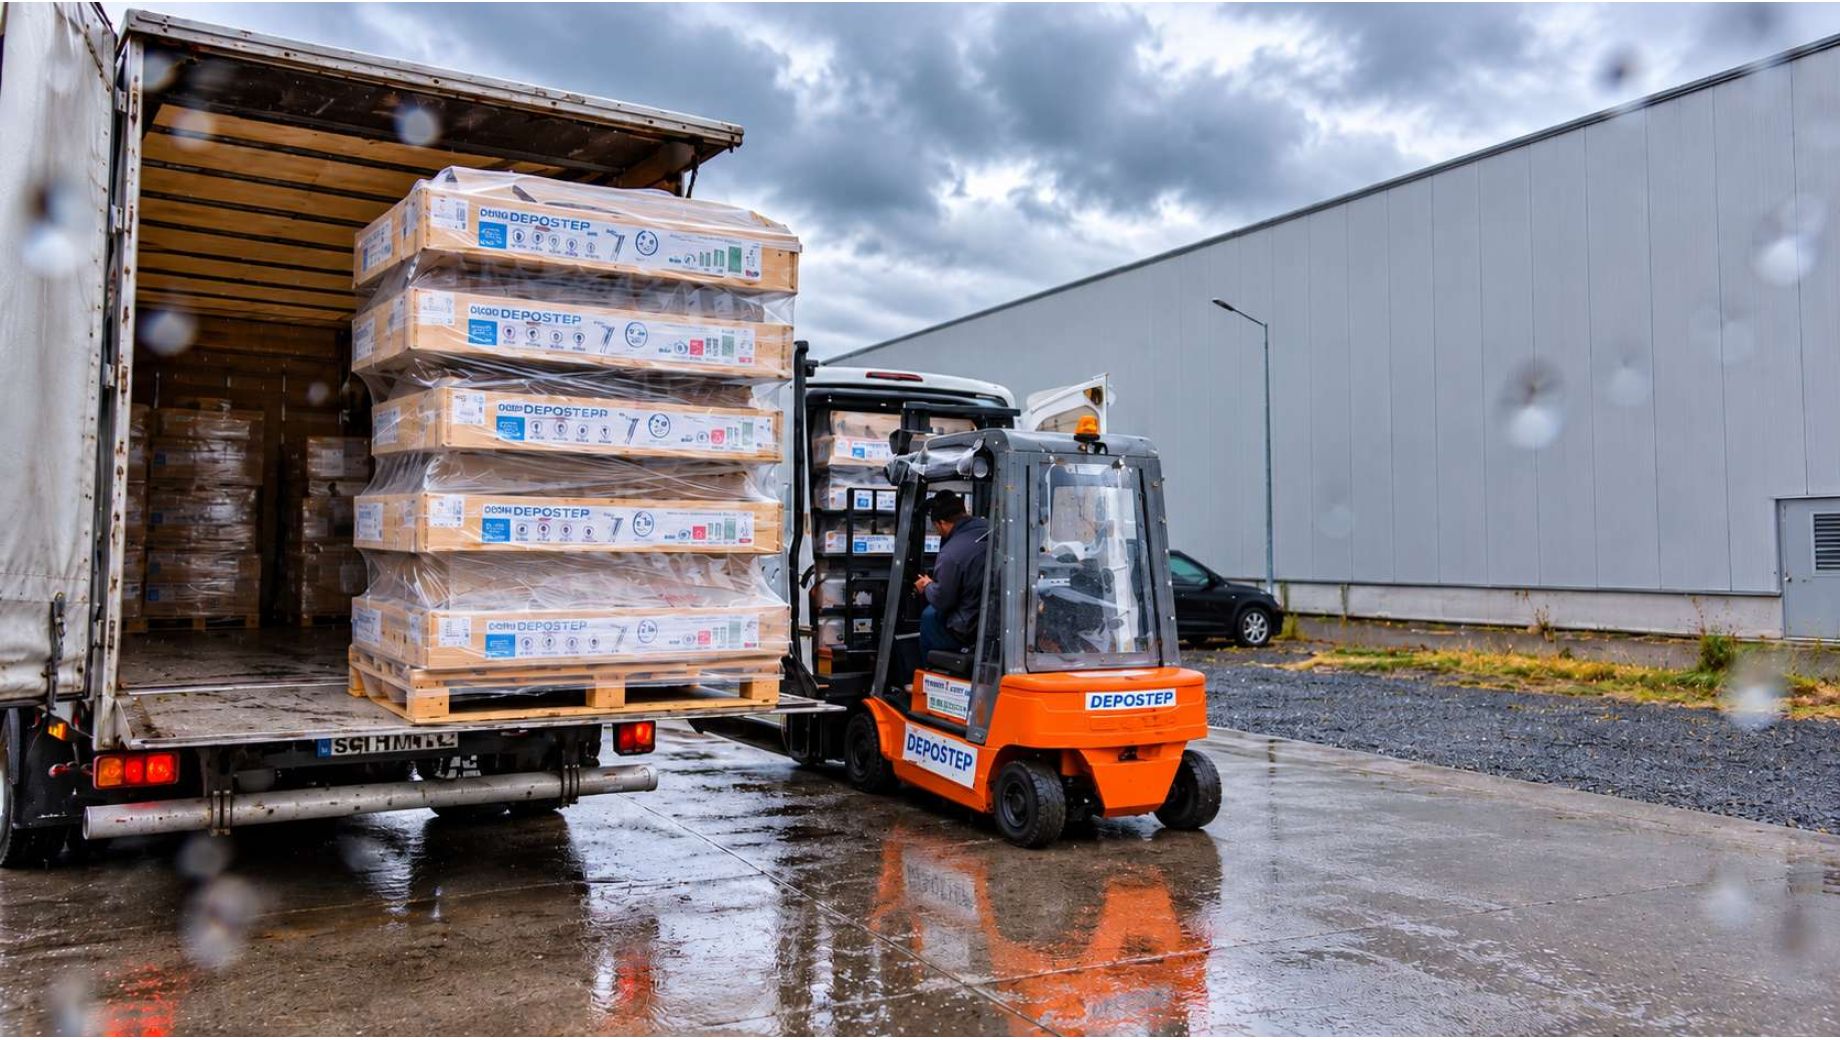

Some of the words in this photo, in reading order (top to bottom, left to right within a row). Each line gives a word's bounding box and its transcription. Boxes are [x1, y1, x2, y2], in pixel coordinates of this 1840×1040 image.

[510, 212, 591, 230] DEPOSTEP
[501, 309, 582, 324] DEPOSTEP
[514, 506, 590, 519] DEPOSTEP
[517, 621, 588, 632] DEPOSTEP
[1090, 692, 1173, 708] DEPOSTEP
[907, 733, 973, 771] DEPOSTEP
